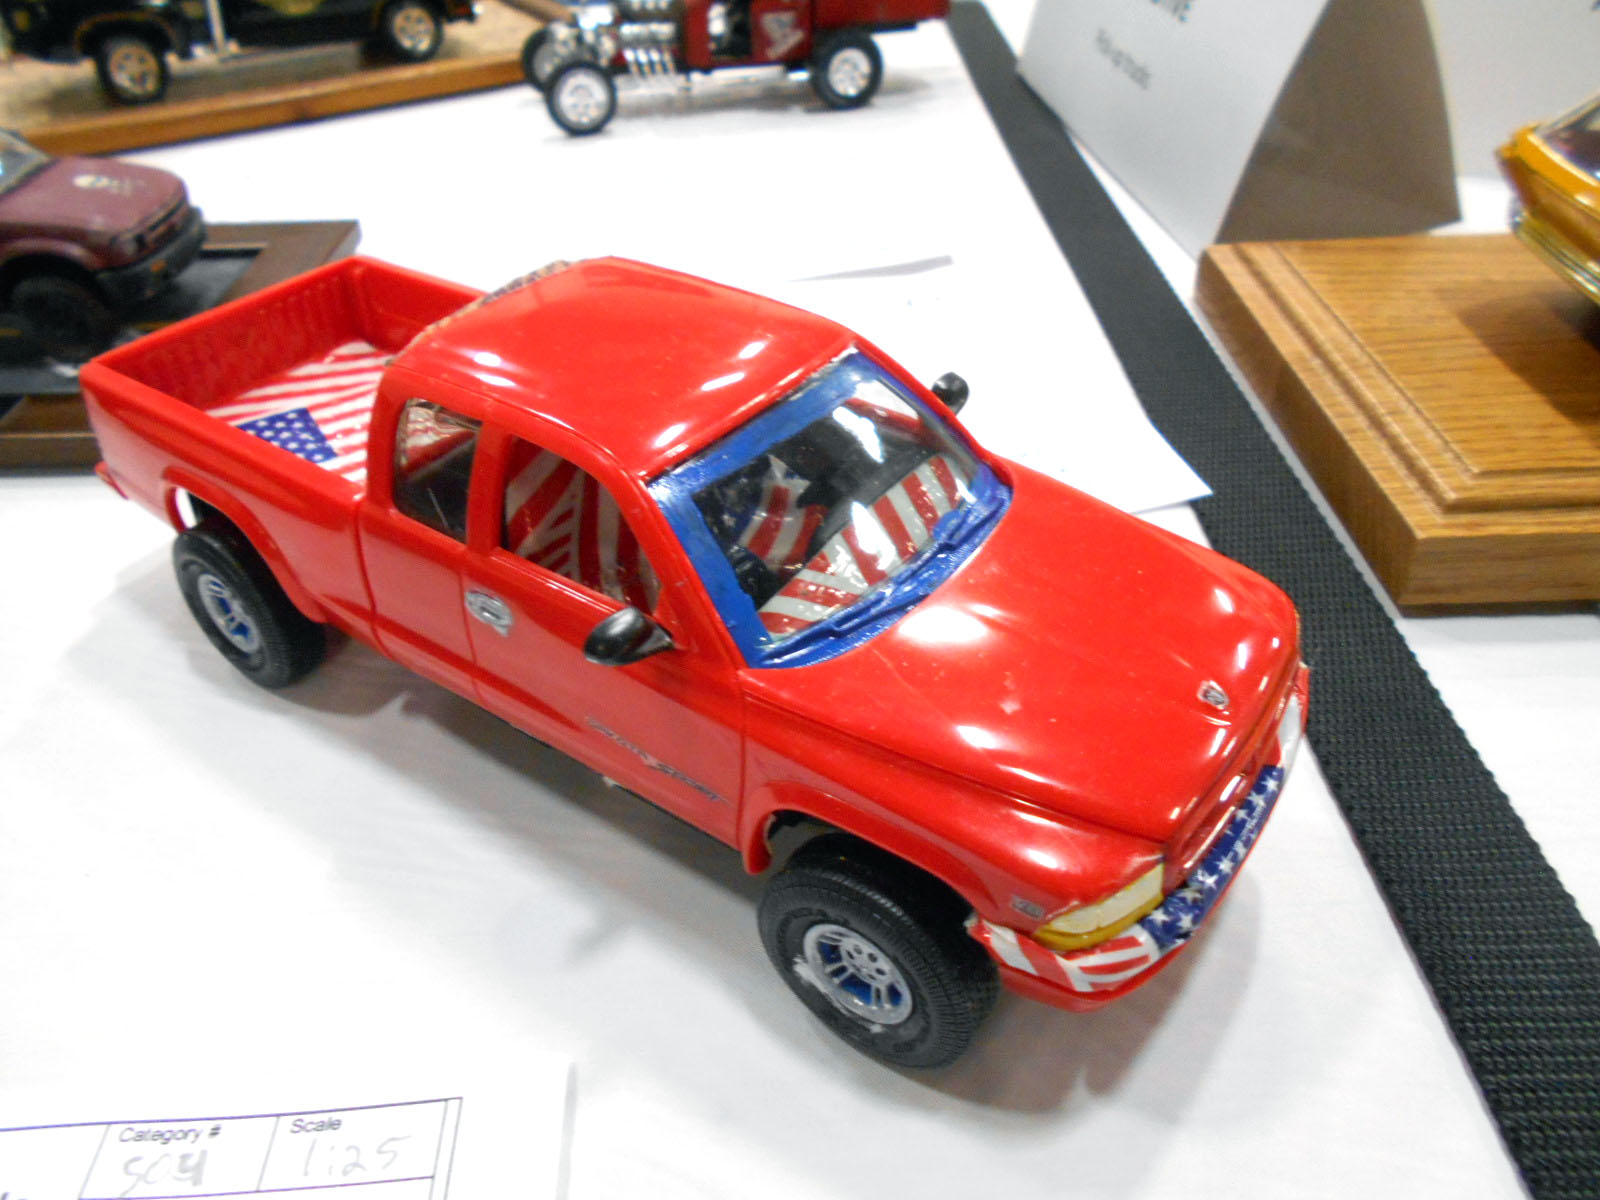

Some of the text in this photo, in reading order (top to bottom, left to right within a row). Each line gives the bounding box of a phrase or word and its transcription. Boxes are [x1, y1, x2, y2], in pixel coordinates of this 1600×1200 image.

[290, 1117, 342, 1134] Scale
[118, 1127, 203, 1145] Category
[303, 1135, 412, 1177] 1:25
